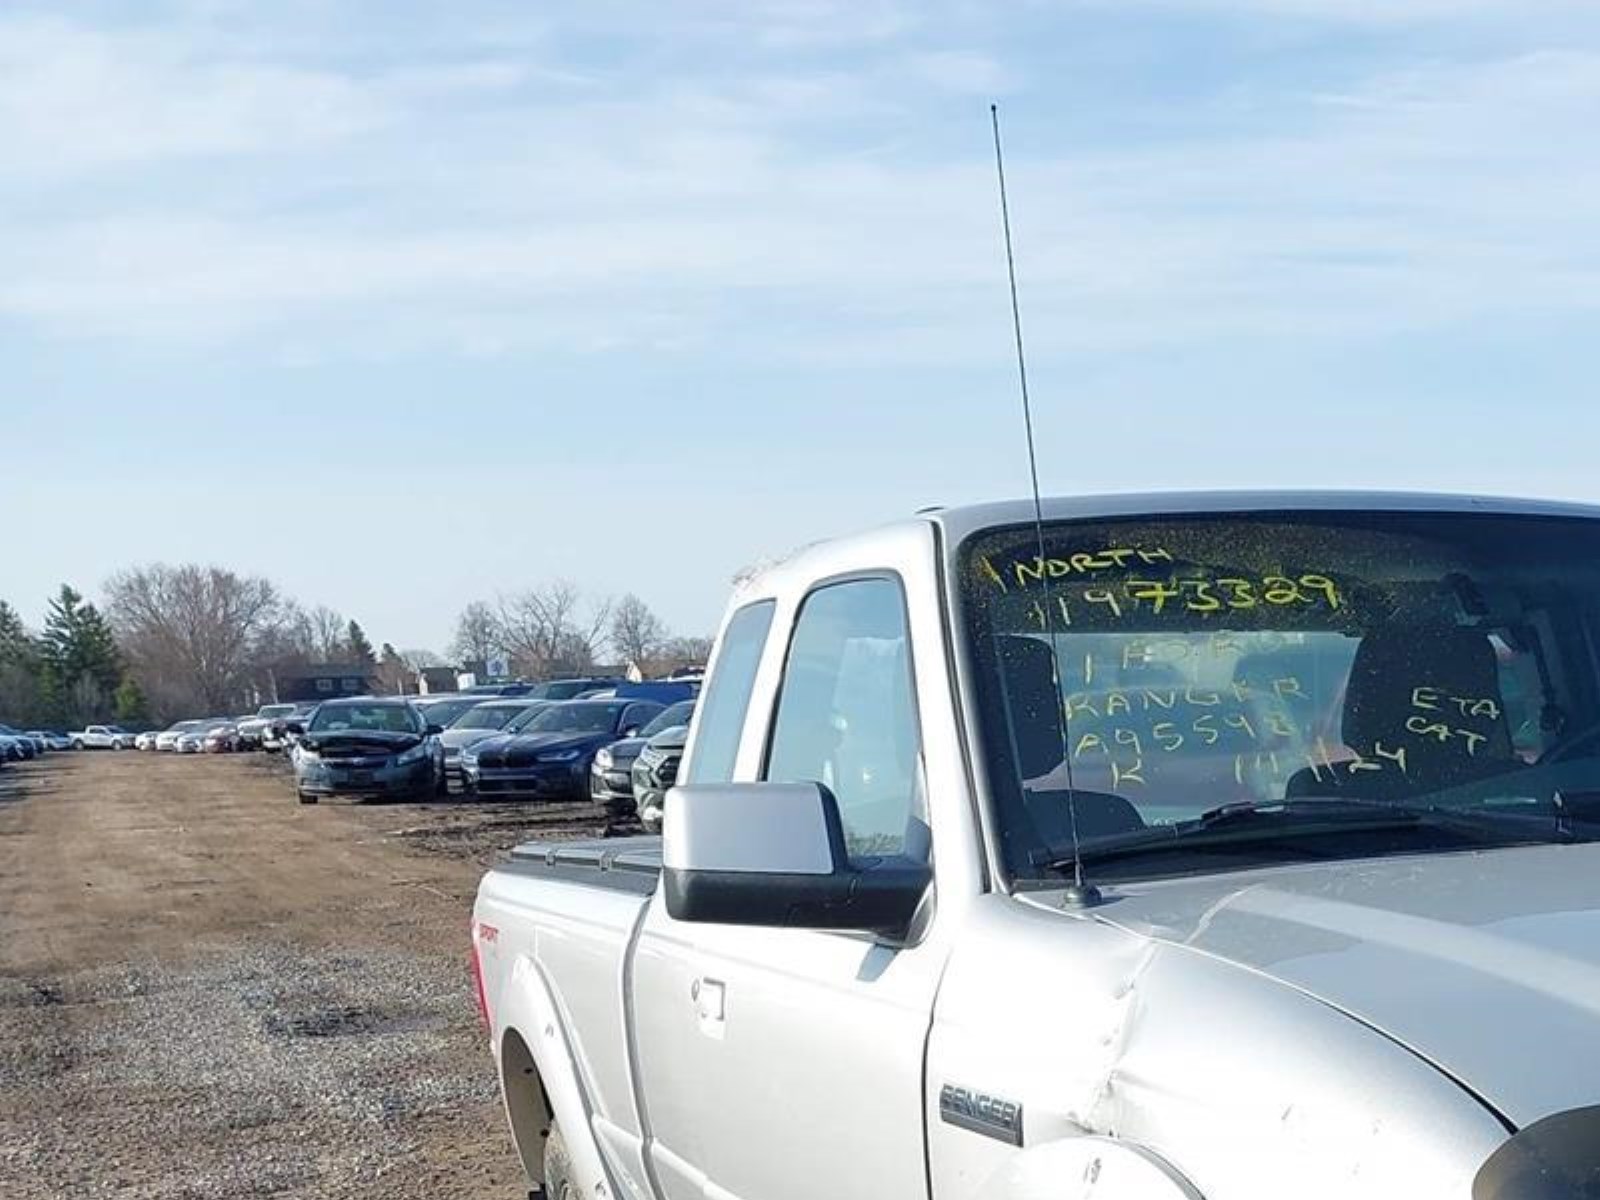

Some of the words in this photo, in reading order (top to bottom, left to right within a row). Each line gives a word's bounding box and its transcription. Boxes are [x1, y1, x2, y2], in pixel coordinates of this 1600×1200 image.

[1014, 547, 1174, 587] NORTH
[1410, 686, 1500, 721] ETA
[1404, 716, 1488, 757] CAT
